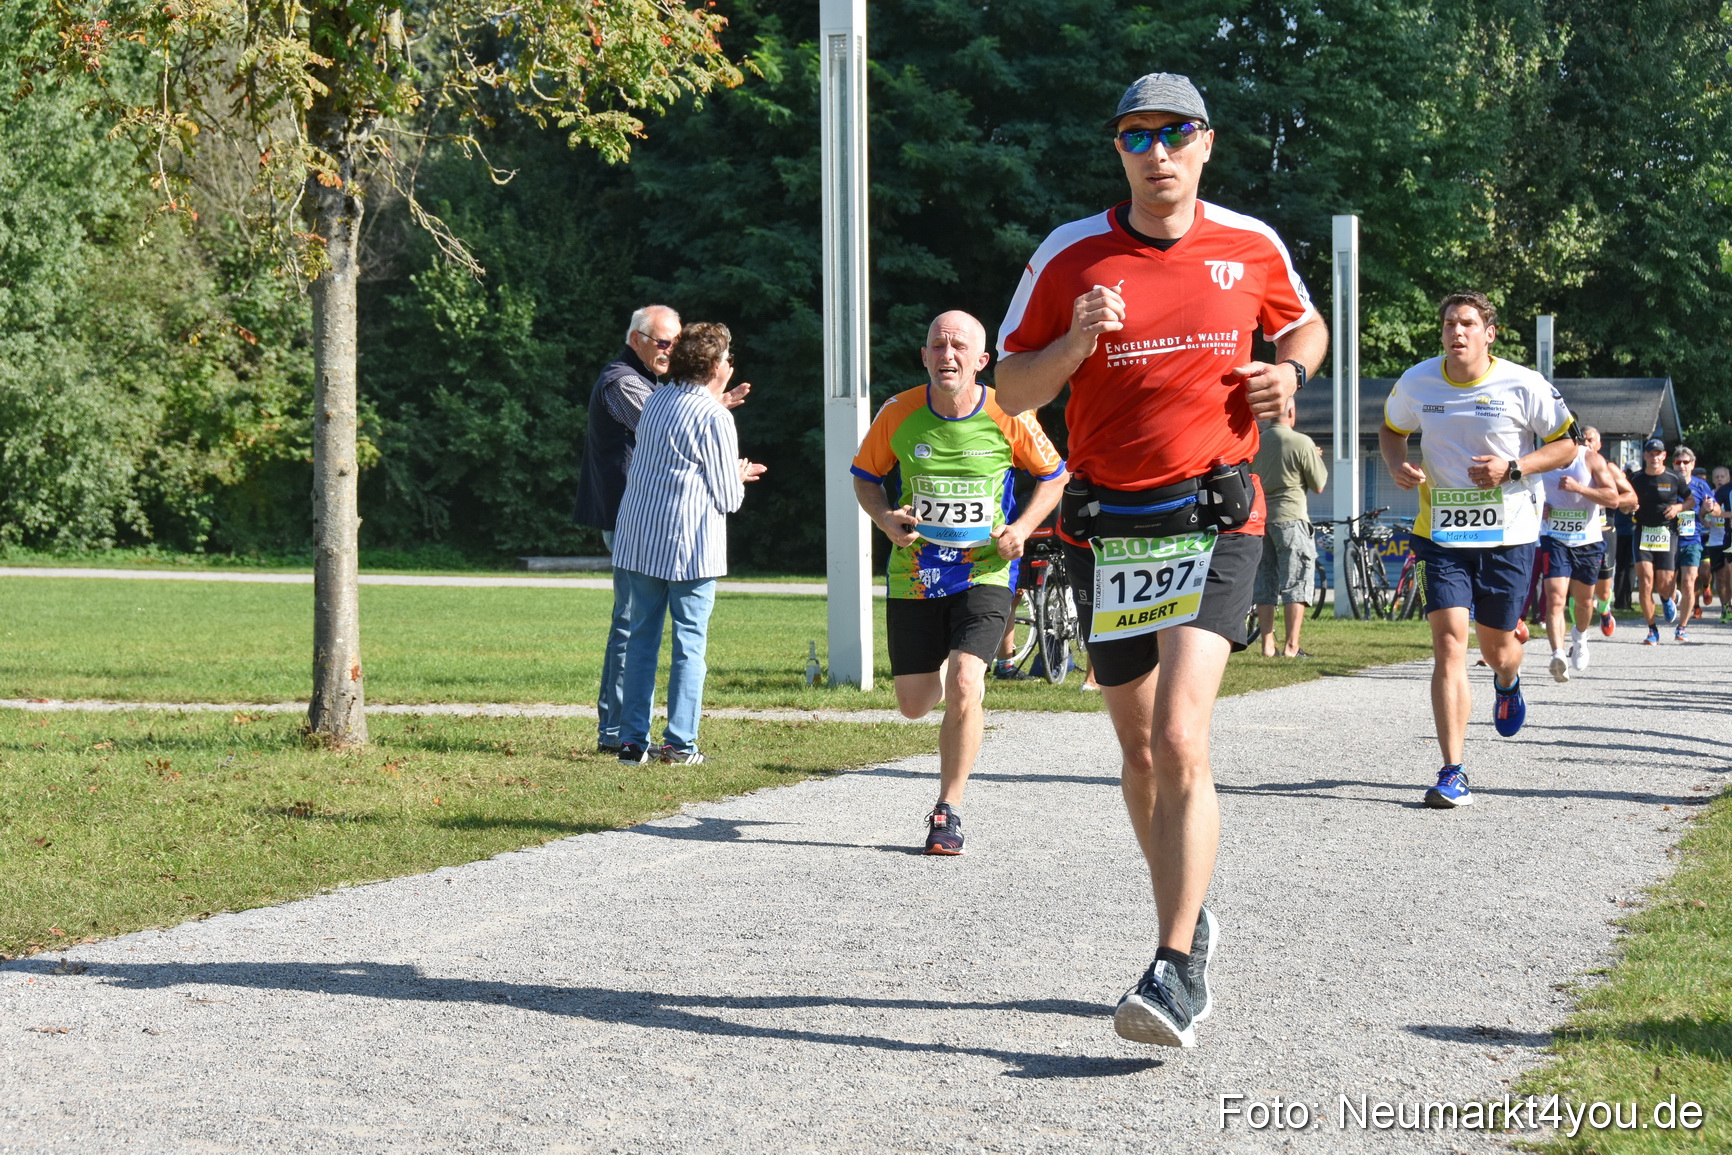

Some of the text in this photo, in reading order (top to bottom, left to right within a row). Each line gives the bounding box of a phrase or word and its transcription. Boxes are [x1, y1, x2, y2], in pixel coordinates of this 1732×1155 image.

[1105, 329, 1239, 354] ENGELHARDT & WALTER
[1214, 347, 1236, 356] Lauf
[1107, 357, 1148, 369] Amberg
[1475, 410, 1501, 418] Stadtlauf
[917, 478, 987, 497] BOCK
[1436, 488, 1498, 505] BOCK
[921, 499, 984, 524] 2733
[1440, 508, 1497, 528] 2820
[1551, 509, 1585, 519] BOCK
[936, 528, 969, 539] WERNER
[1552, 520, 1583, 532] 2256
[1446, 531, 1479, 541] Markus
[1646, 534, 1667, 543] 1009
[1103, 533, 1206, 561] BOCK
[1374, 539, 1416, 557] CAF
[1110, 560, 1195, 604] 1297
[1115, 601, 1178, 628] ALBERT
